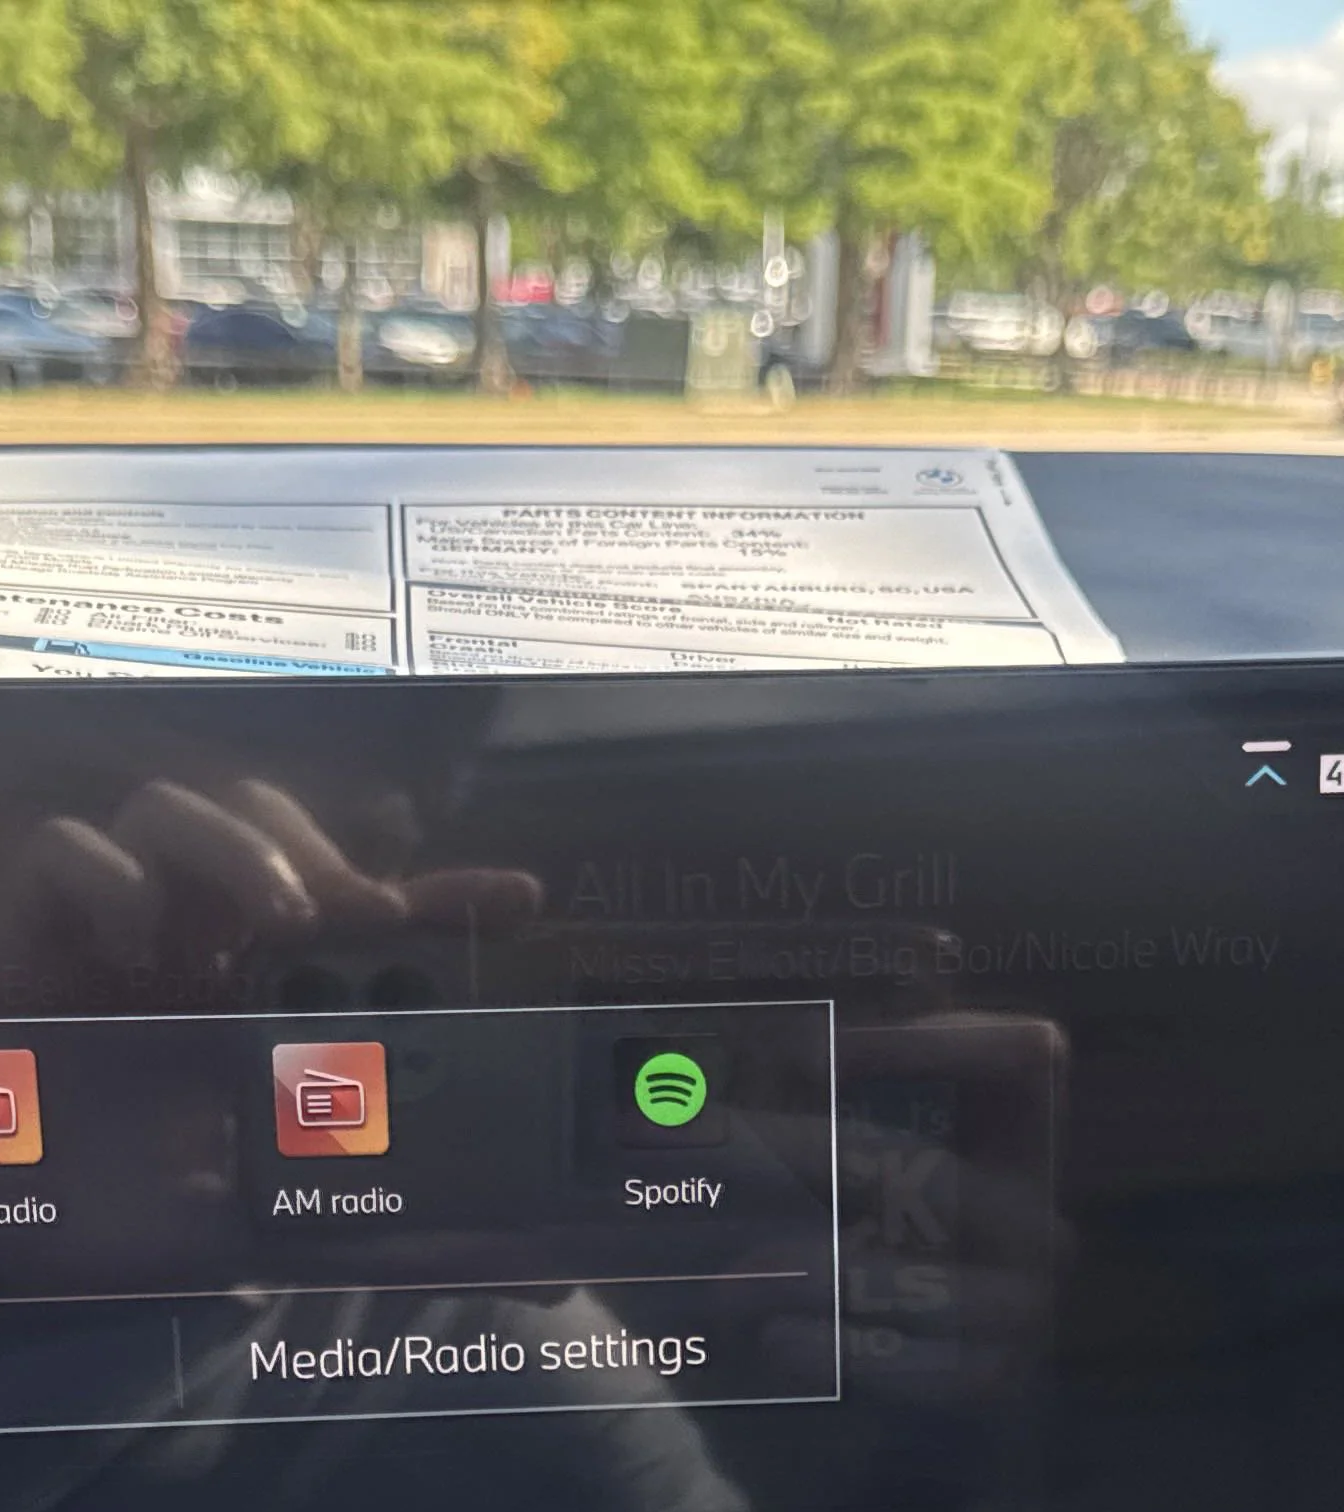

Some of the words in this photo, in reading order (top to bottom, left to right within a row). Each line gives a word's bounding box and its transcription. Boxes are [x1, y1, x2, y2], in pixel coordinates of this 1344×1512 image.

[502, 509, 581, 519] PARTS
[586, 510, 696, 520] CONTENT
[702, 510, 866, 522] INFORMATION
[427, 588, 513, 603] Overall
[519, 594, 607, 608] Vehicle
[613, 600, 682, 613] Score
[174, 606, 285, 626] Costs
[428, 634, 518, 648] Frontal
[737, 855, 826, 923] My
[844, 851, 957, 910] Grill
[1169, 924, 1280, 971] Wray
[272, 1188, 323, 1217] AM
[330, 1187, 403, 1216] radio
[623, 1177, 723, 1211] Spotify
[249, 1334, 526, 1383] Media/Radio
[539, 1331, 707, 1374] settings
